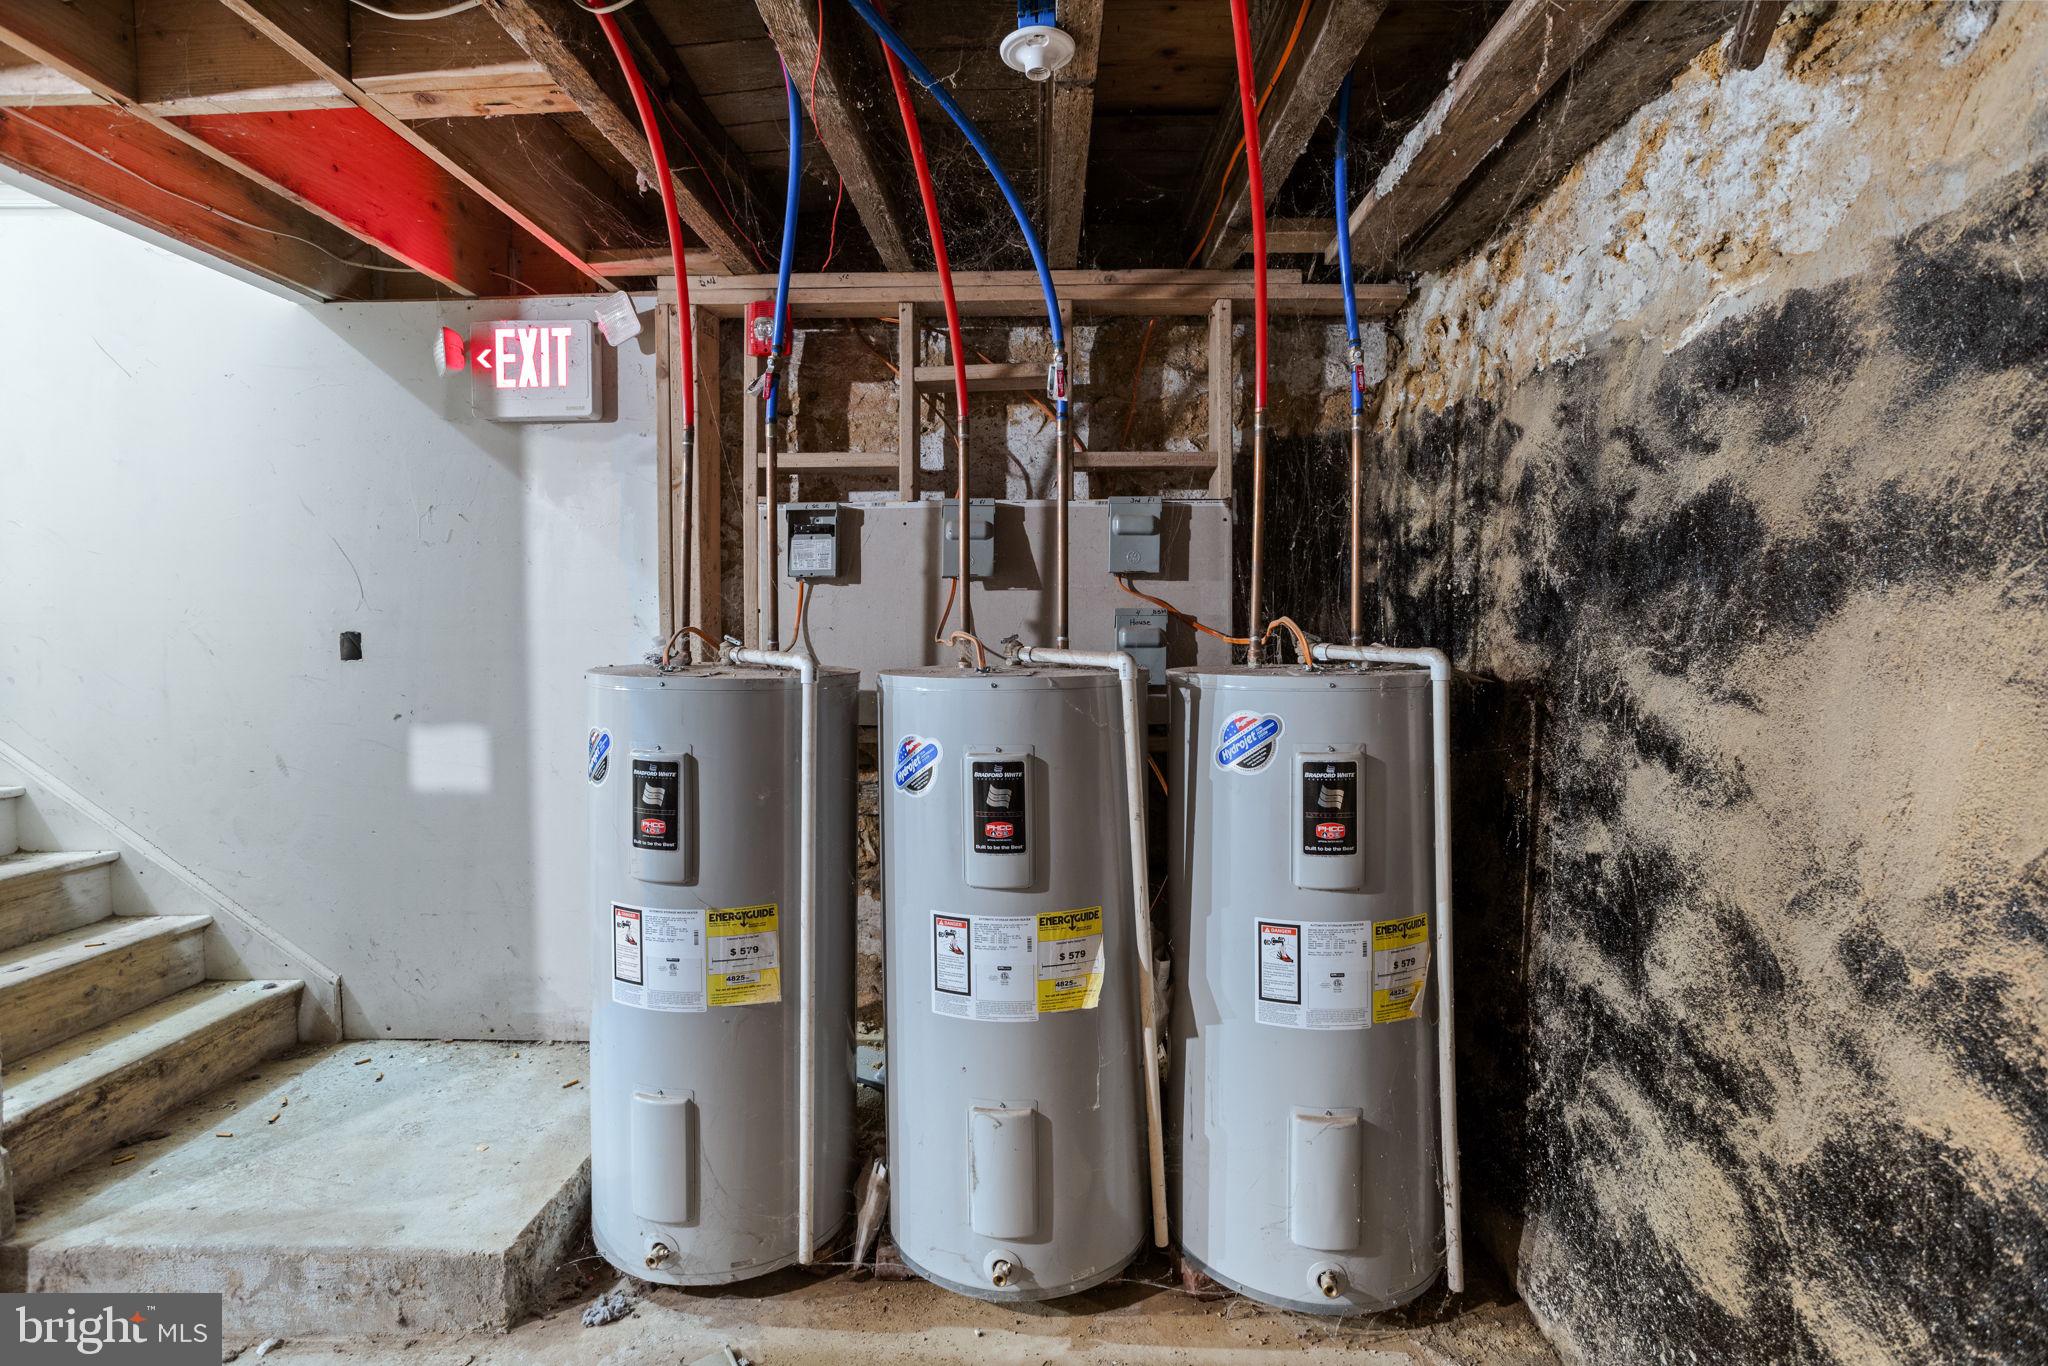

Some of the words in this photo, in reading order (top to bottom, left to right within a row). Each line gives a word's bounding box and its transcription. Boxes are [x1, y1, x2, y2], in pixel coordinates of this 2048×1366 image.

[495, 327, 572, 389] EXIT
[1129, 618, 1151, 626] House
[1221, 731, 1257, 761] Hydrojet
[633, 769, 658, 777] BRADFORD
[709, 907, 775, 922] ENERGYGUIDE
[1040, 911, 1099, 926] ENERGYGUIDE
[1271, 927, 1292, 935] DANGER
[1376, 917, 1426, 936] ENERGYGUIDE
[731, 947, 737, 957] $
[740, 946, 759, 955] 579
[1060, 952, 1065, 962] $
[1069, 950, 1086, 960] 579
[1394, 961, 1399, 970] $
[1402, 958, 1416, 968] 579
